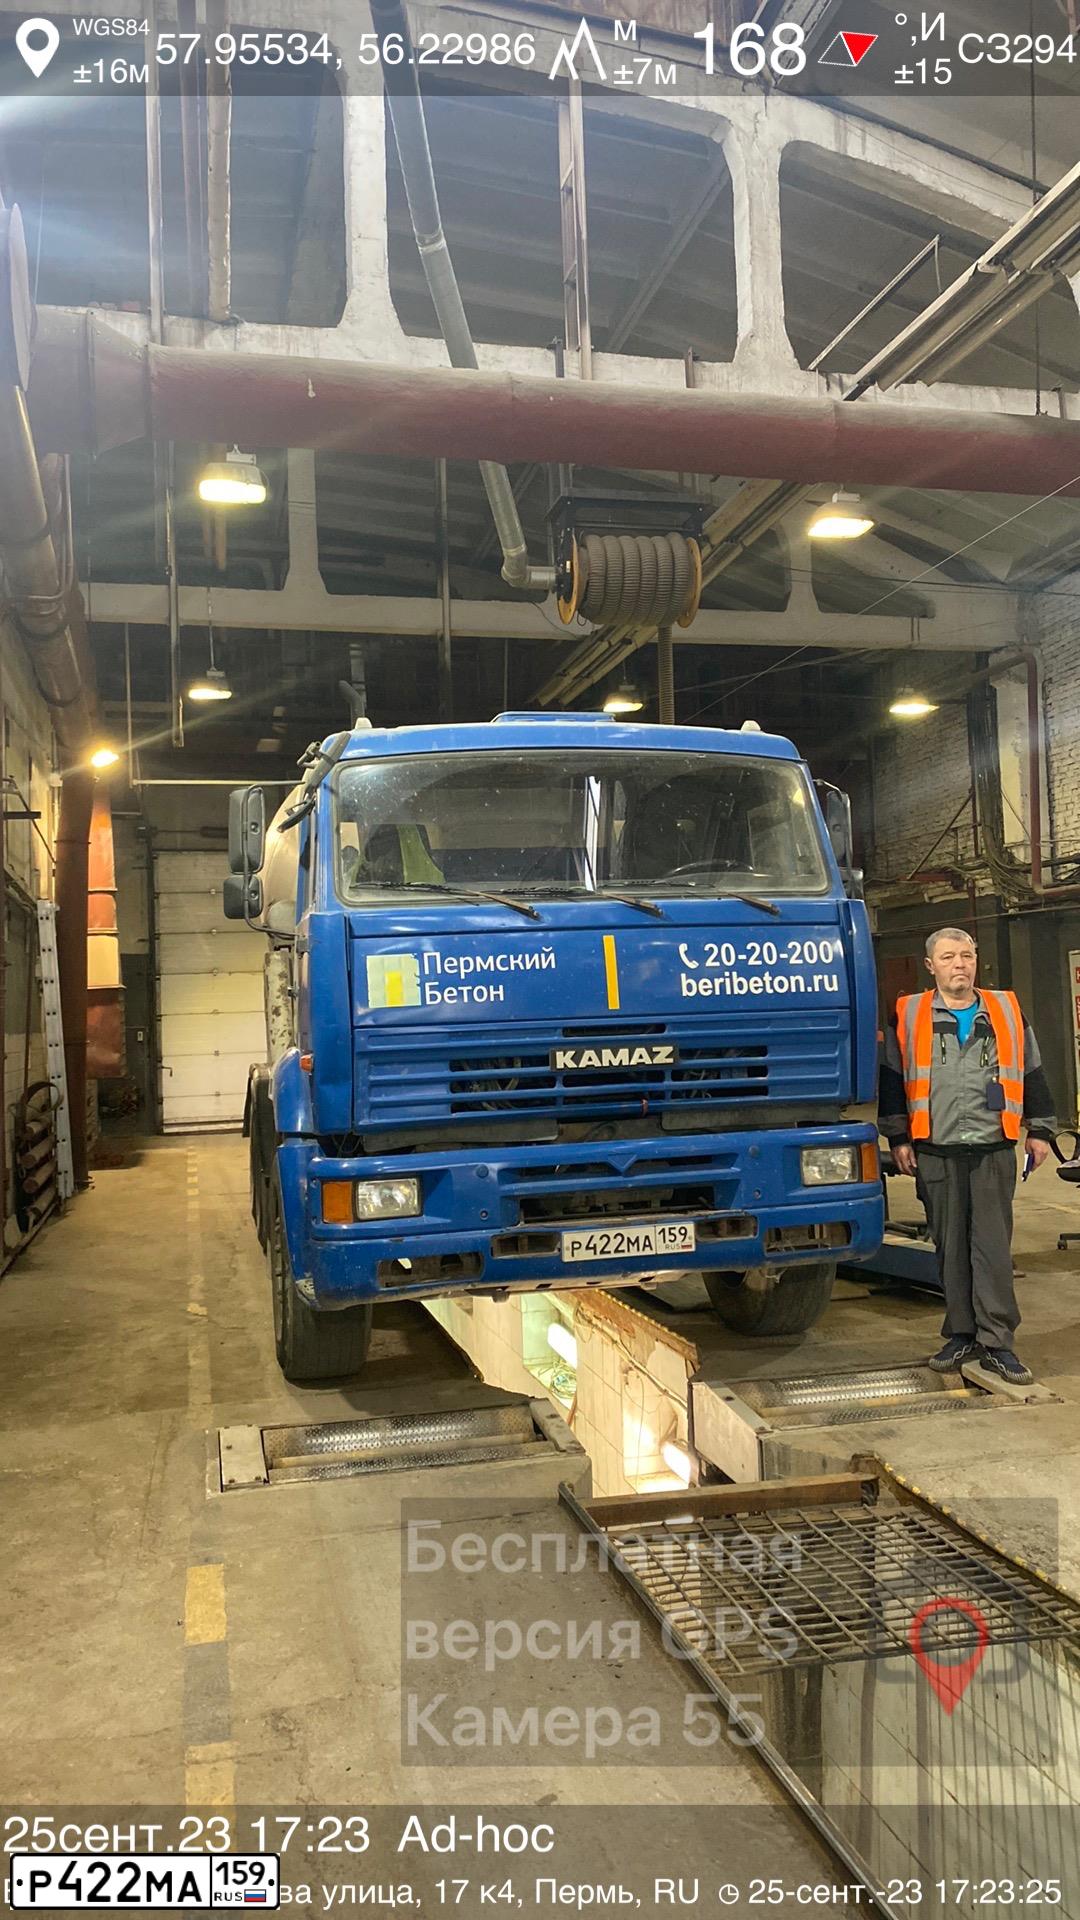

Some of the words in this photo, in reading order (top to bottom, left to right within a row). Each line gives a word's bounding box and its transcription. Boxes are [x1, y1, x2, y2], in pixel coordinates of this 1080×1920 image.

[423, 946, 556, 979] Пермский
[704, 940, 833, 967] 20-20-200
[425, 981, 504, 1005] Бетон
[680, 970, 838, 997] beribeton.ru
[555, 1046, 674, 1069] KAMAZ
[570, 1232, 653, 1258] Р422МА
[658, 1226, 688, 1244] 159
